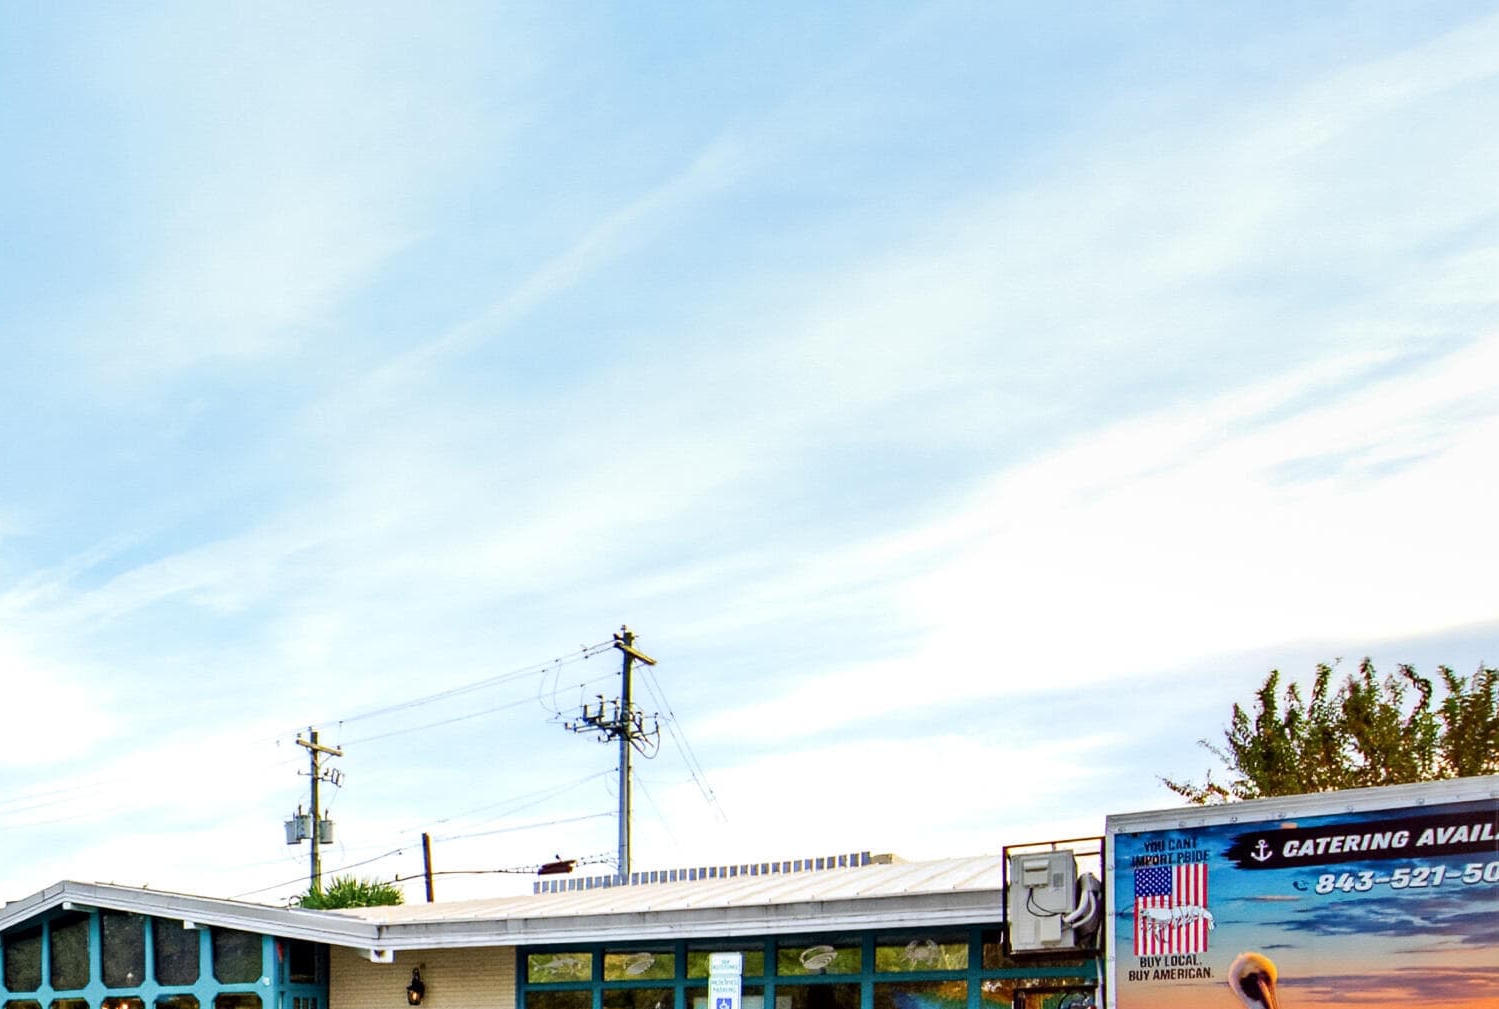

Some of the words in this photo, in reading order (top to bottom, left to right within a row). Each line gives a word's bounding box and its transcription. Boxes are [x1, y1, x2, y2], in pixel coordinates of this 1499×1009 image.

[1144, 840, 1165, 852] YOU
[1282, 830, 1410, 858] CATERING
[1415, 823, 1499, 847] AVAIL
[1132, 852, 1173, 867] IMPORT
[1177, 850, 1210, 864] PRIDE
[1315, 862, 1499, 895] 843-521-50
[1140, 956, 1161, 968] BUY
[1128, 970, 1150, 981] BUY
